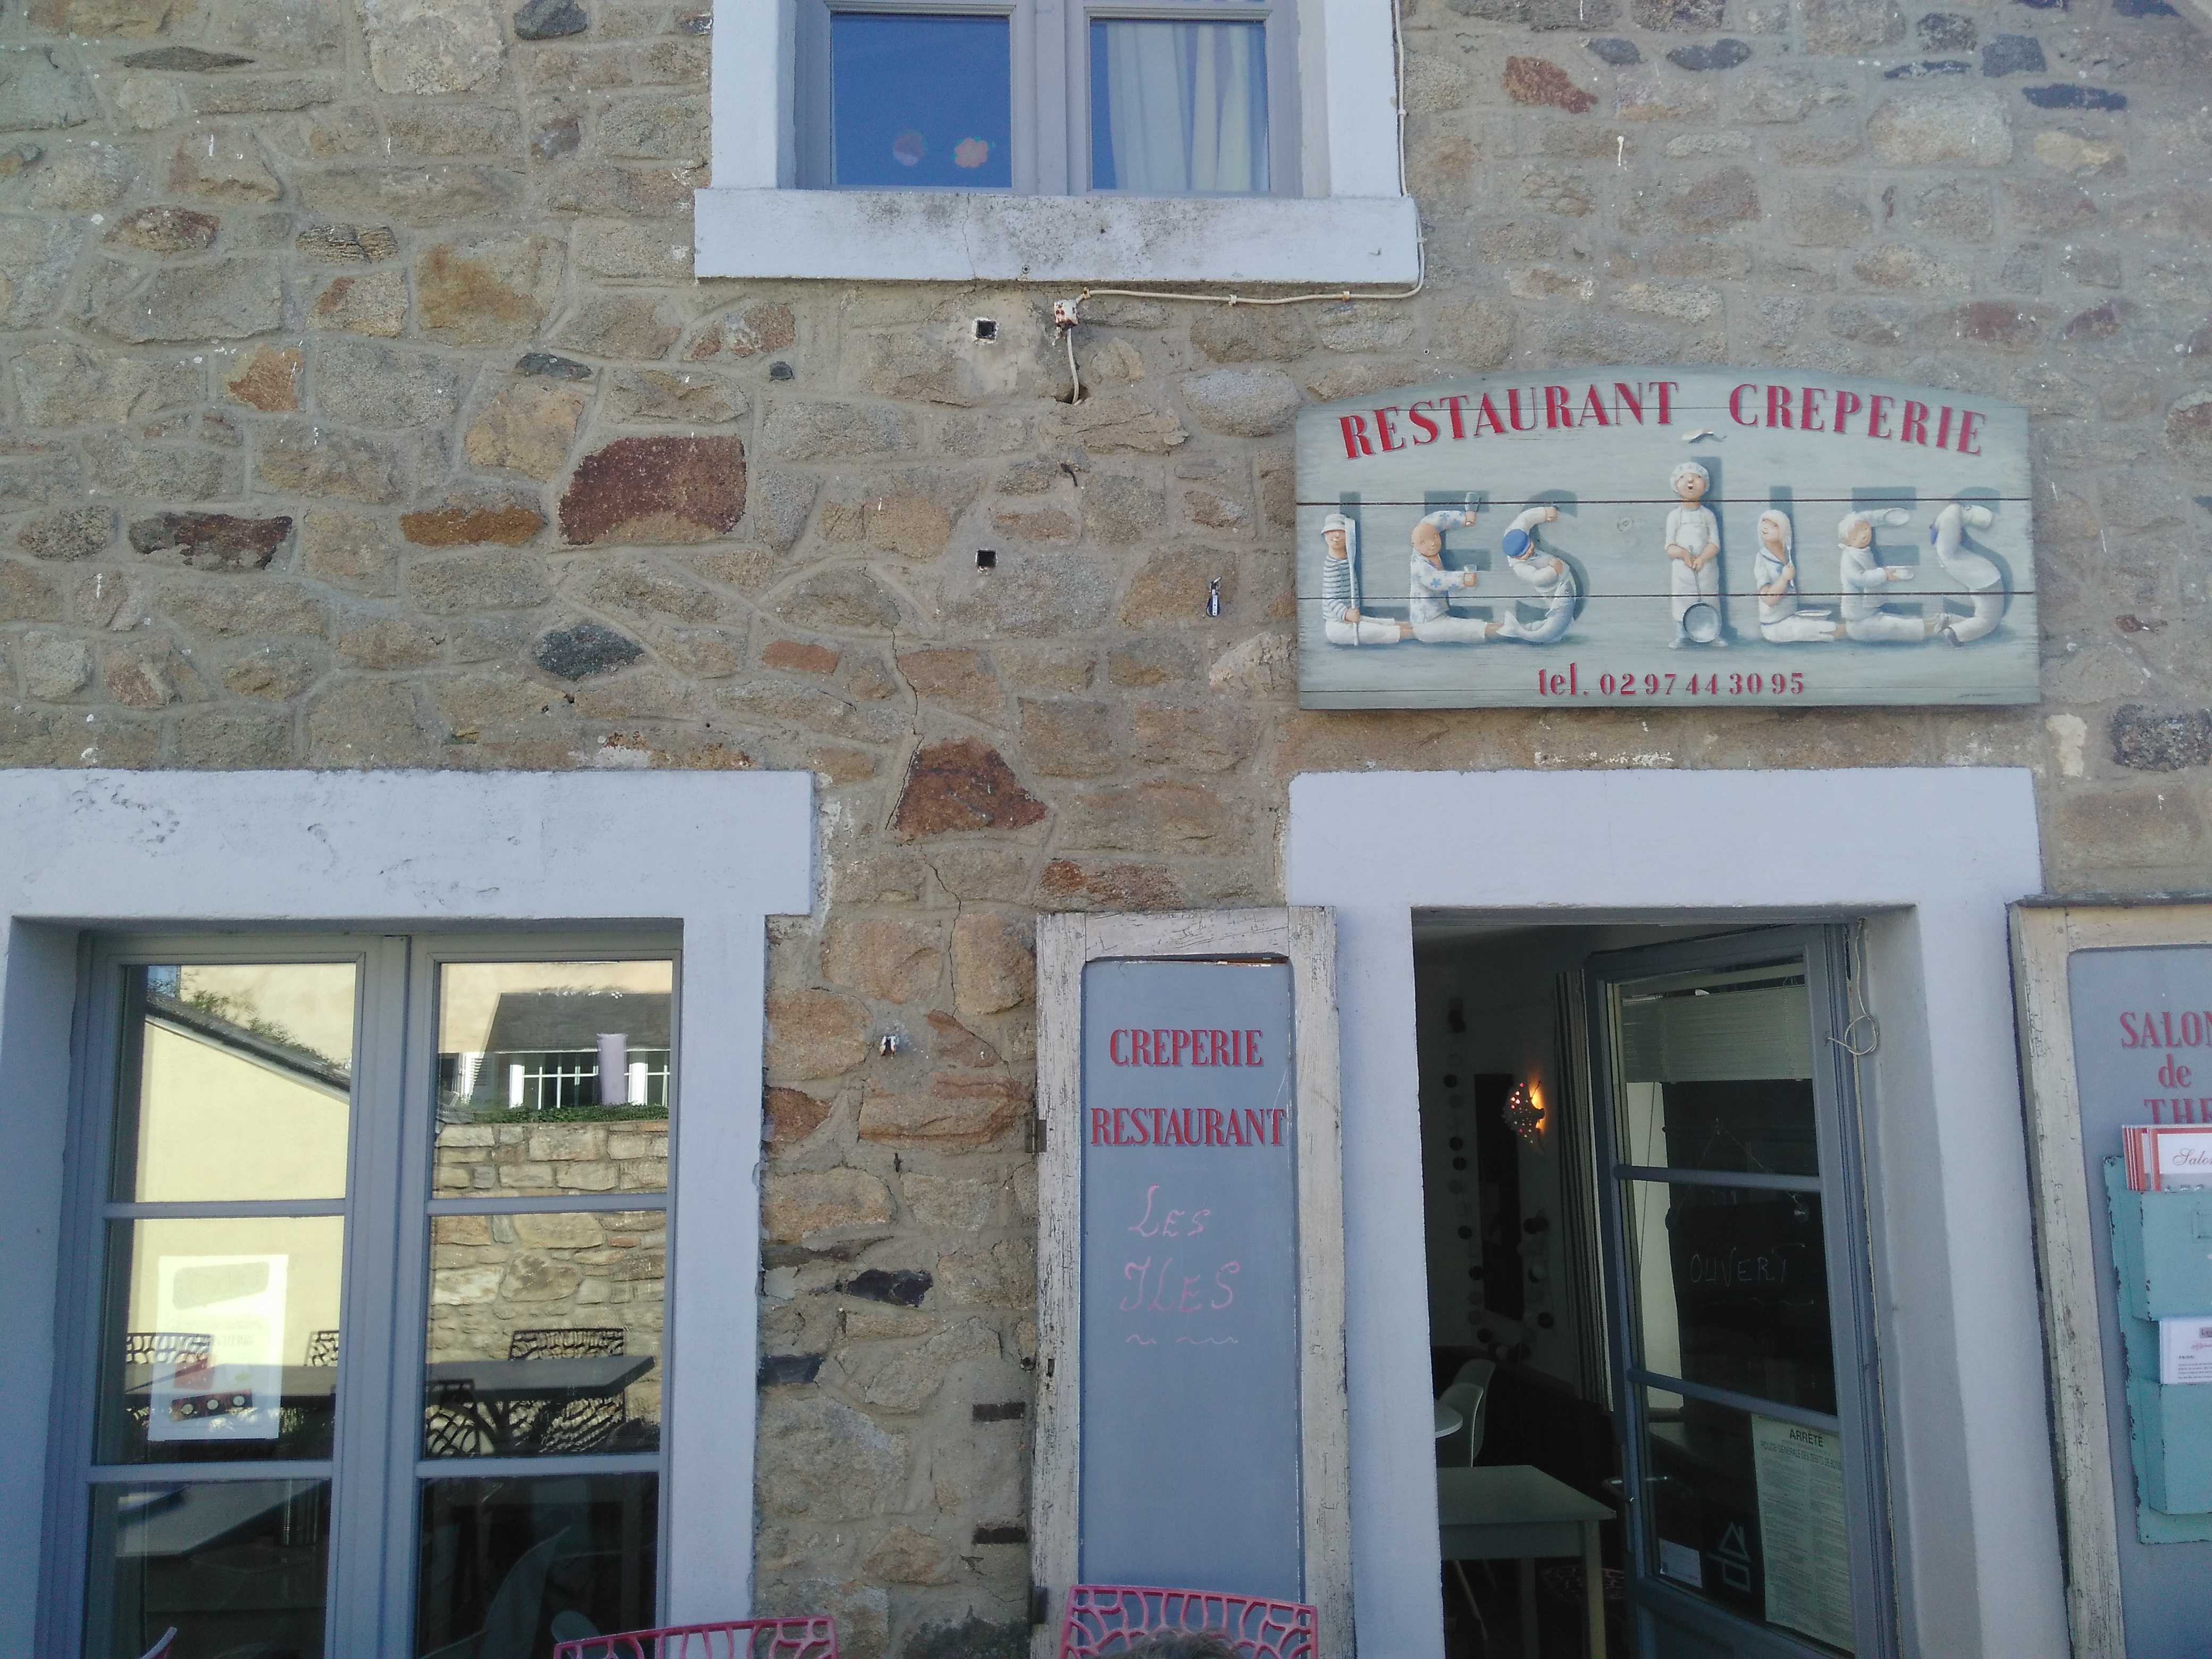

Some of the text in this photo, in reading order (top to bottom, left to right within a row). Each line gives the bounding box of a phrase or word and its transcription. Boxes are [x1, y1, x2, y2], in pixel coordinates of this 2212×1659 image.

[1338, 381, 1987, 459] RESTAURANT CREPERIE
[1320, 490, 1590, 646] LES
[1538, 661, 1589, 696] tel.
[1109, 1028, 1263, 1066] CREPERIE
[2158, 1053, 2191, 1088] de
[1090, 1108, 1285, 1146] RESTAURANT
[2172, 1148, 2212, 1166] Salo
[1690, 1243, 1806, 1286] OUVERT
